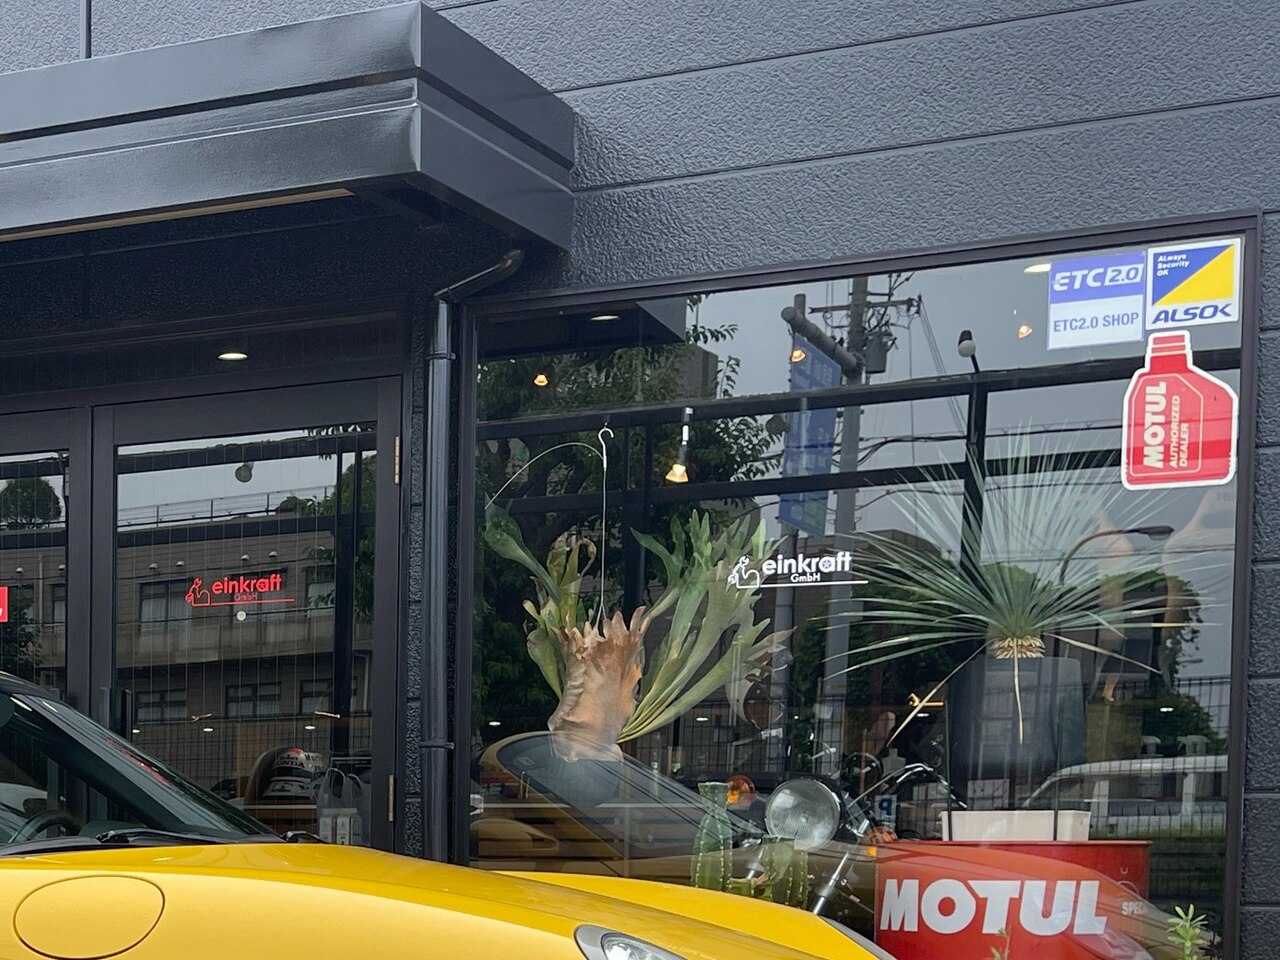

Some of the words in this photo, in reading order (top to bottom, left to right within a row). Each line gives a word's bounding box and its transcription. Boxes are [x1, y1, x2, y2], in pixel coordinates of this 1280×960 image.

[1156, 269, 1169, 277] OK
[1053, 316, 1098, 333] ETC2.0
[1103, 312, 1140, 328] SHOP
[1152, 303, 1232, 324] ALSOK
[1144, 381, 1167, 469] MOTUL
[1169, 395, 1180, 468] AUTHORIZED
[1179, 423, 1189, 467] DEALER
[762, 551, 852, 575] einkraft
[212, 573, 282, 595] einkraft
[790, 573, 821, 583] GmbH
[880, 878, 1108, 936] MOTUL
